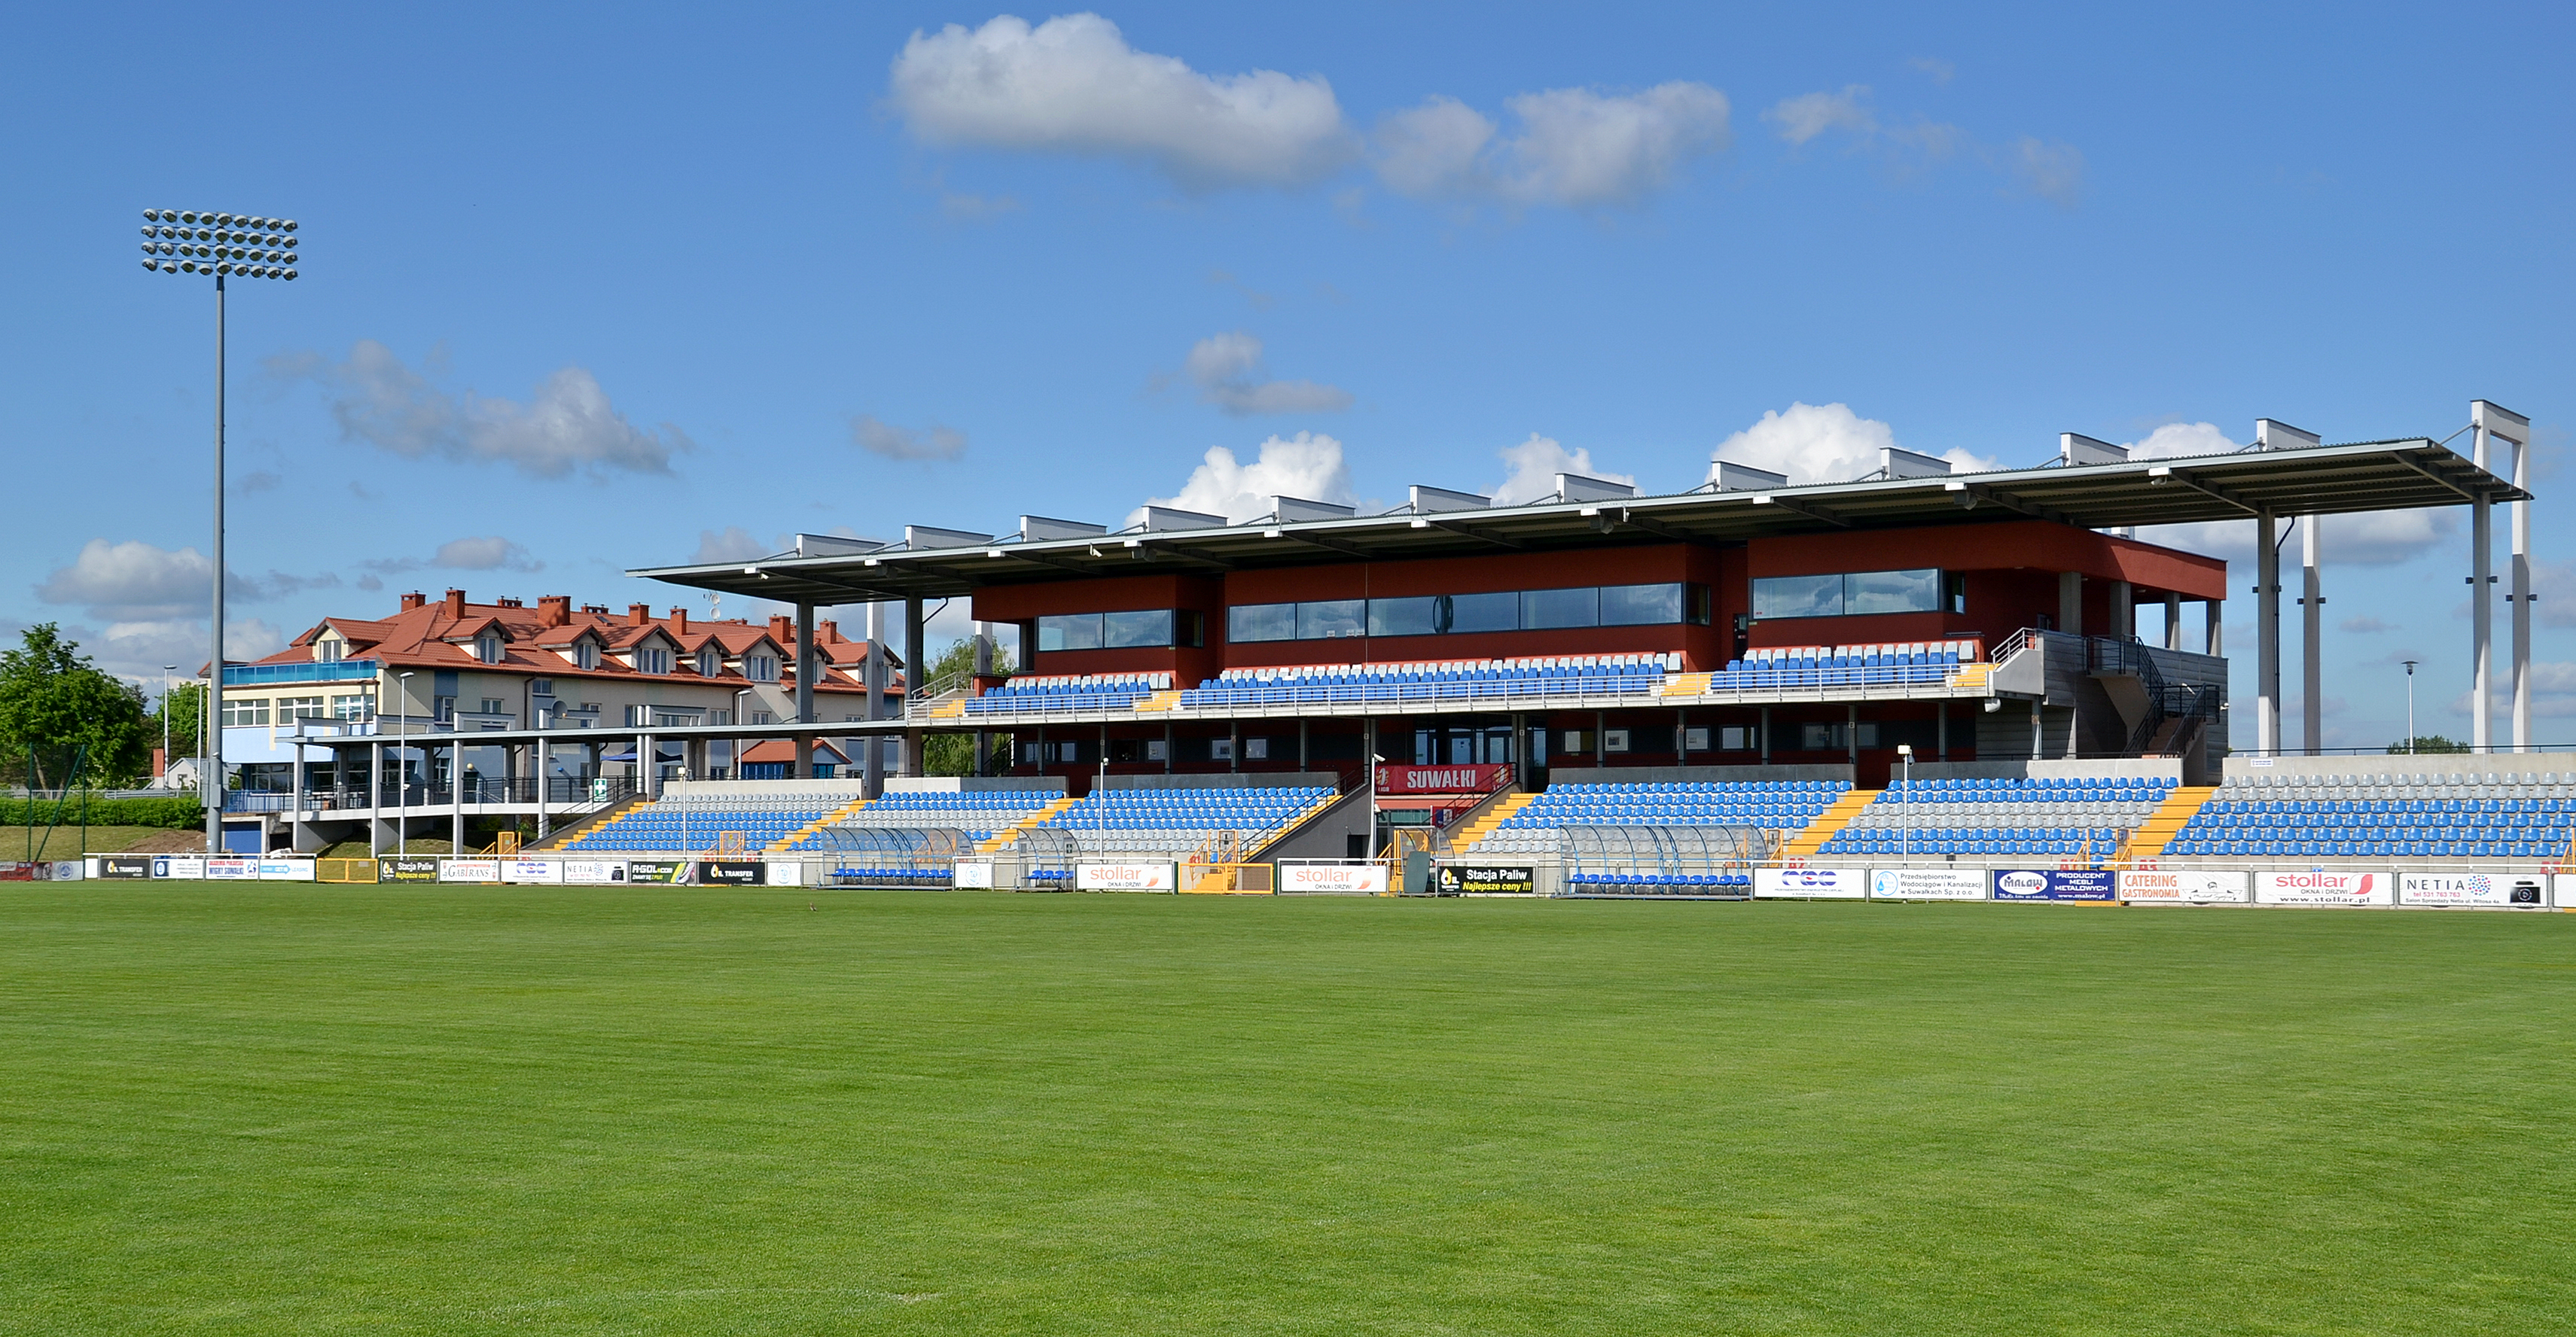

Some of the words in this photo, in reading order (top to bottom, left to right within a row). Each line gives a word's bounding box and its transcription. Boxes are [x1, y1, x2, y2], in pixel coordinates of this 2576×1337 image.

[1407, 769, 1476, 788] SUWAŁKI
[398, 862, 416, 872] Stacja
[417, 862, 434, 870] Paliw
[1090, 866, 1142, 880] stollar
[1296, 868, 1352, 882] stollar
[1466, 869, 1497, 882] Stacja
[1499, 869, 1527, 880] Paliw
[2124, 875, 2178, 887] CATERING
[2276, 873, 2349, 887] stollar
[1462, 882, 1501, 892] Najlepsze
[1501, 883, 1521, 892] ceny
[1522, 882, 1532, 890] !!!
[2407, 879, 2465, 890] NETIA
[2122, 889, 2180, 898] GASTRONOMIA
